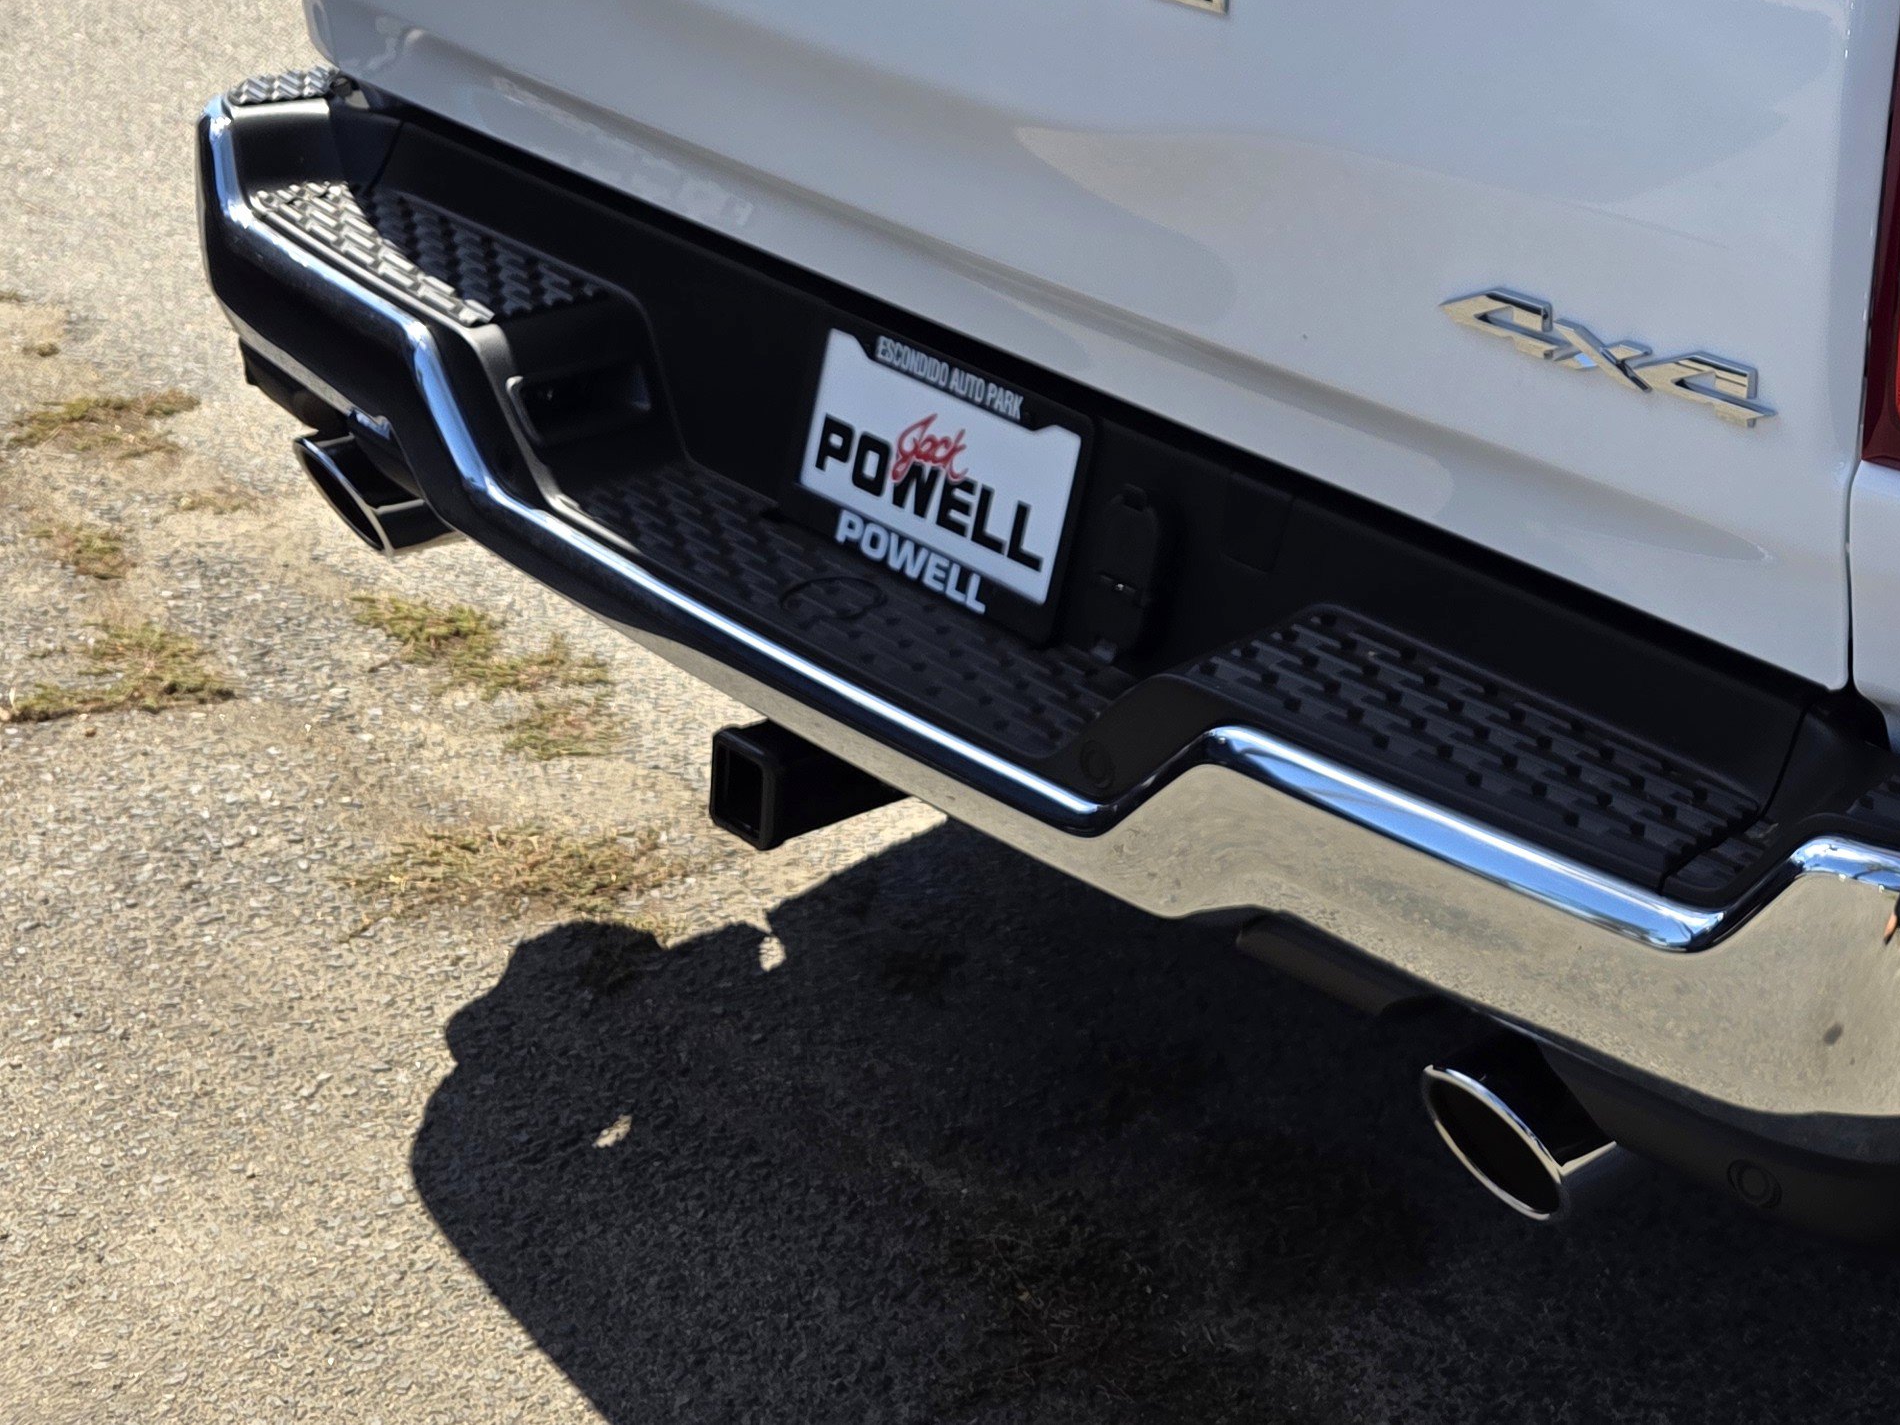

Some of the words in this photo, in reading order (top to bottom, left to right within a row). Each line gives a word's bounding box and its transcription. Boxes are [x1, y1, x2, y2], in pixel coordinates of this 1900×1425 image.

[875, 335, 950, 388] ESCONDIDO
[949, 366, 986, 405] AUTO
[984, 382, 1024, 421] PARK
[815, 413, 1043, 573] POWELL
[891, 413, 968, 481] Jack
[836, 510, 986, 615] POWELL
